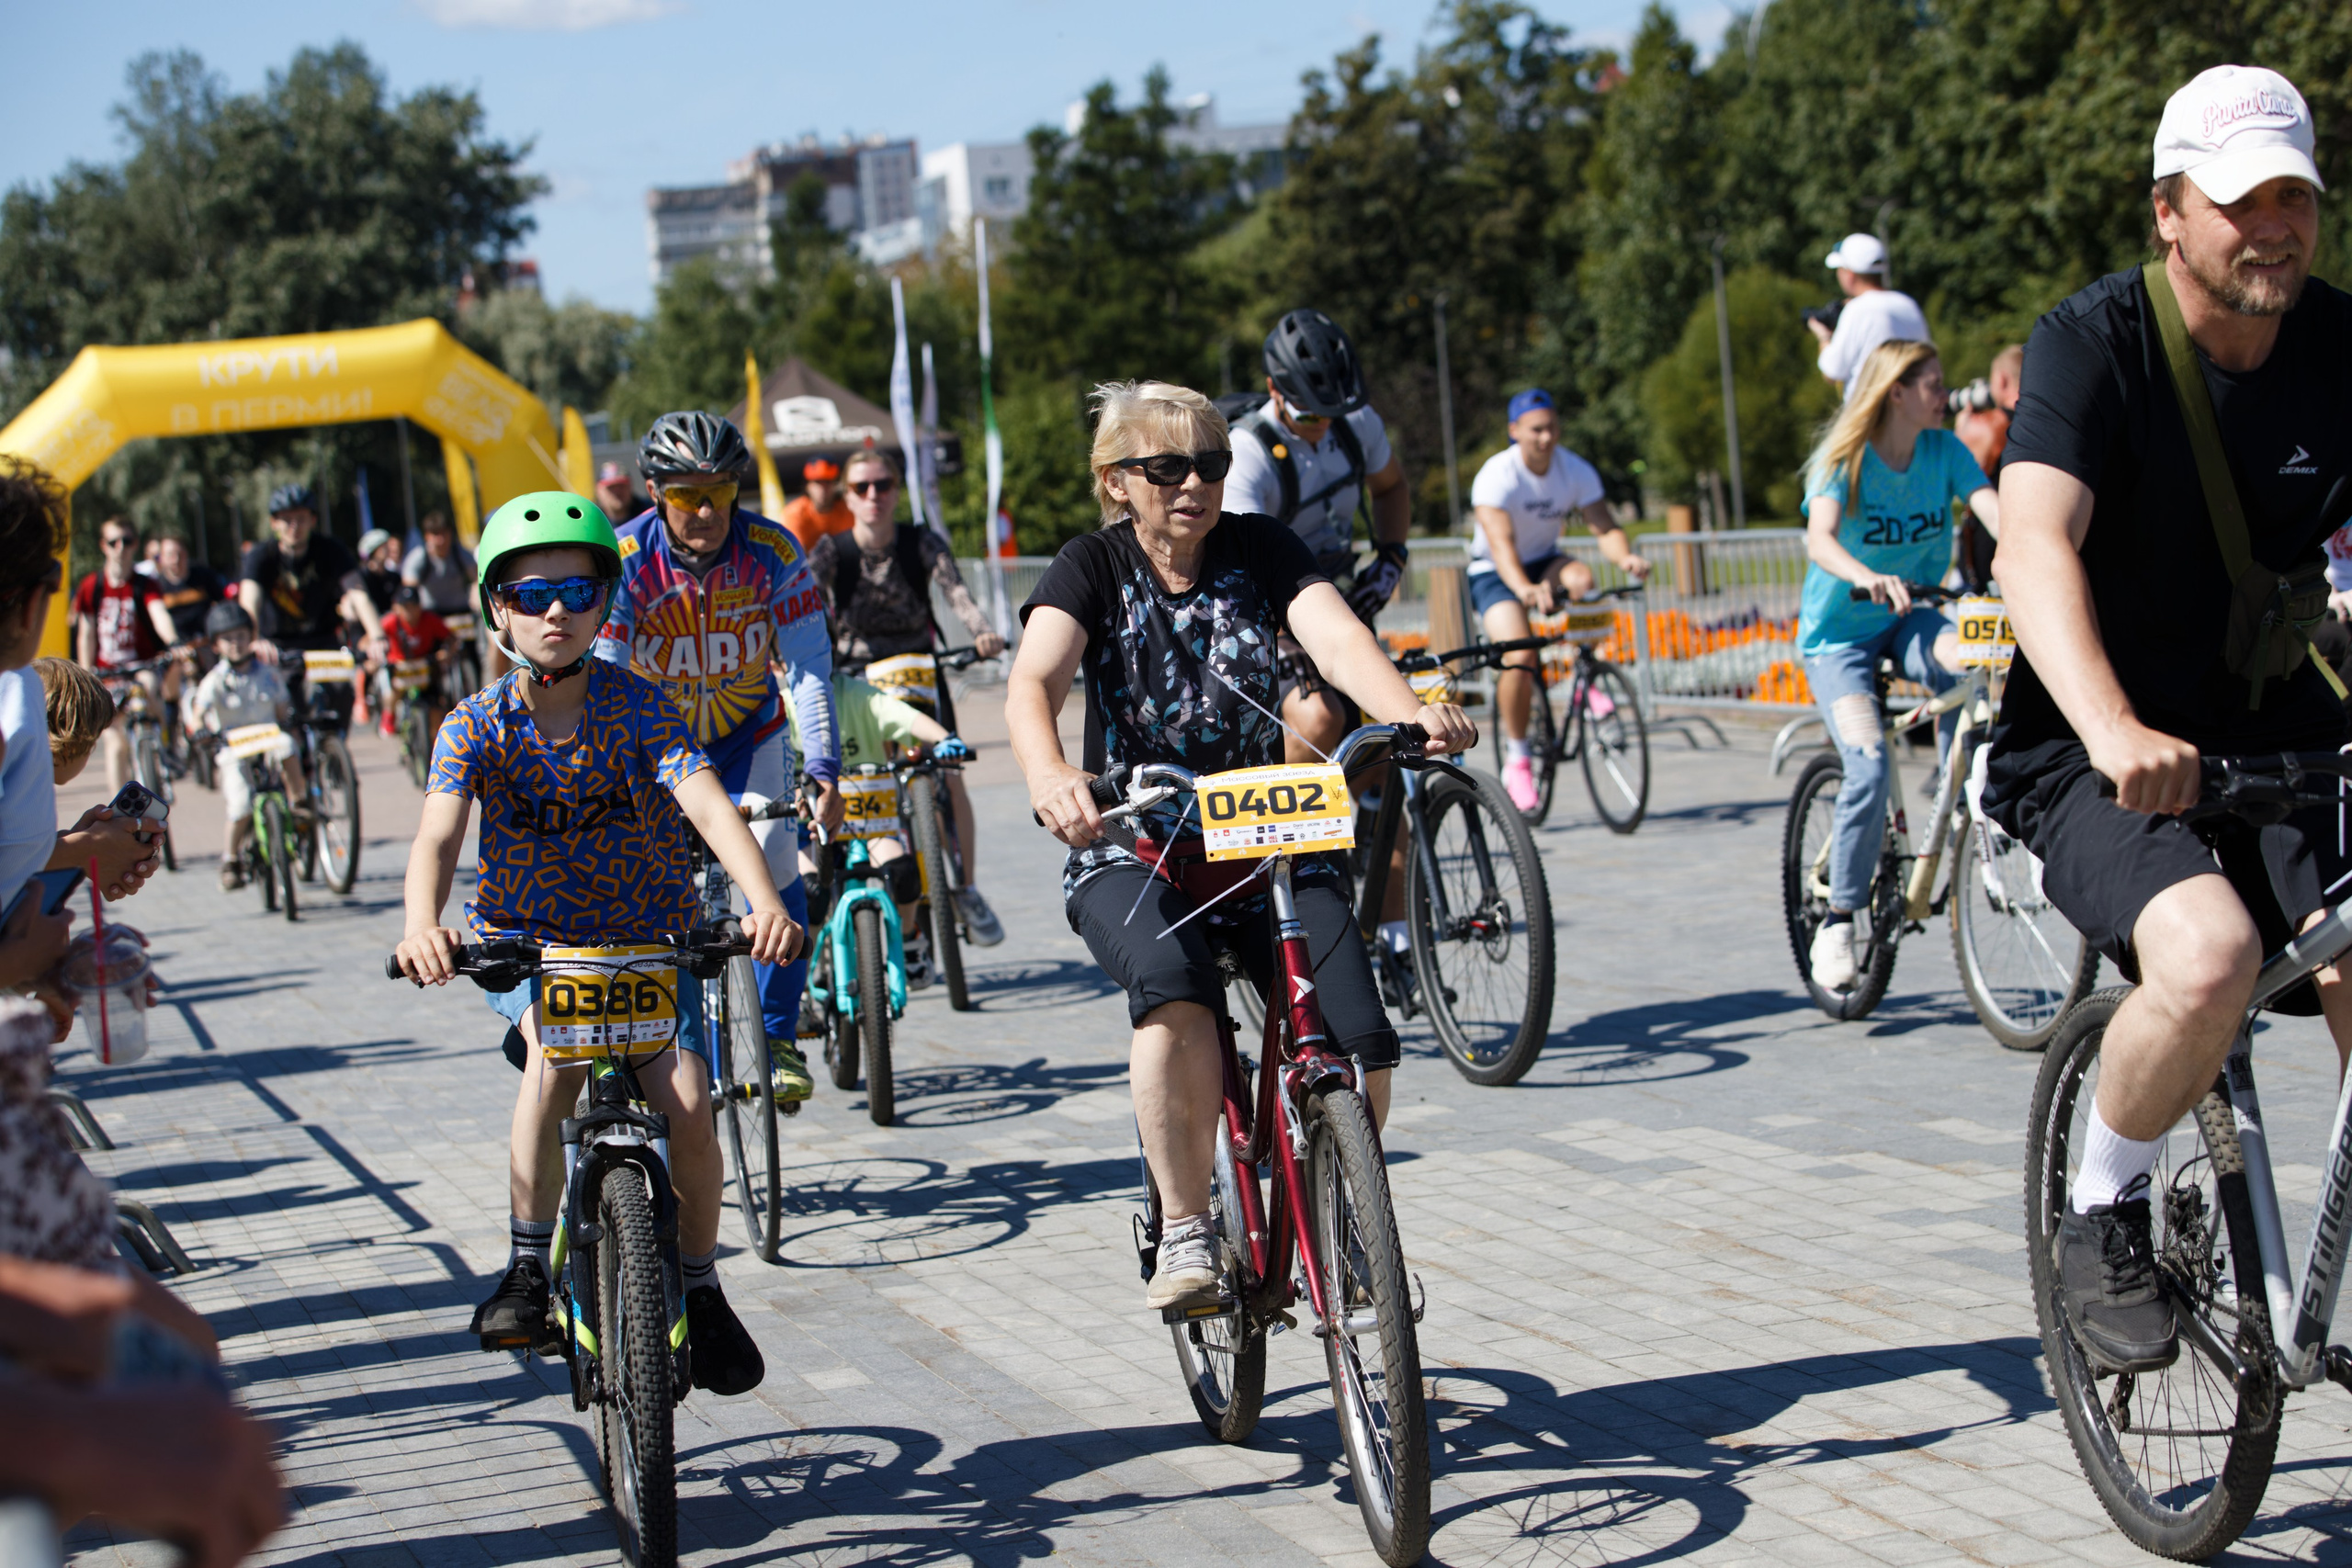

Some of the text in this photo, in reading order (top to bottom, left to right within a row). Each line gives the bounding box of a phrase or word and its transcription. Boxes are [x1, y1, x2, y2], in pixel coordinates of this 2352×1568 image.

[198, 344, 339, 388] КРУТИ
[2278, 466, 2319, 475] DEMIX
[1863, 507, 1945, 545] 20:24
[635, 621, 768, 678] KARO
[661, 671, 745, 695] FILM
[1222, 770, 1316, 782] Массовый заезд
[510, 782, 637, 837] 20:24
[1207, 784, 1326, 820] 0402
[548, 980, 659, 1018] 0386
